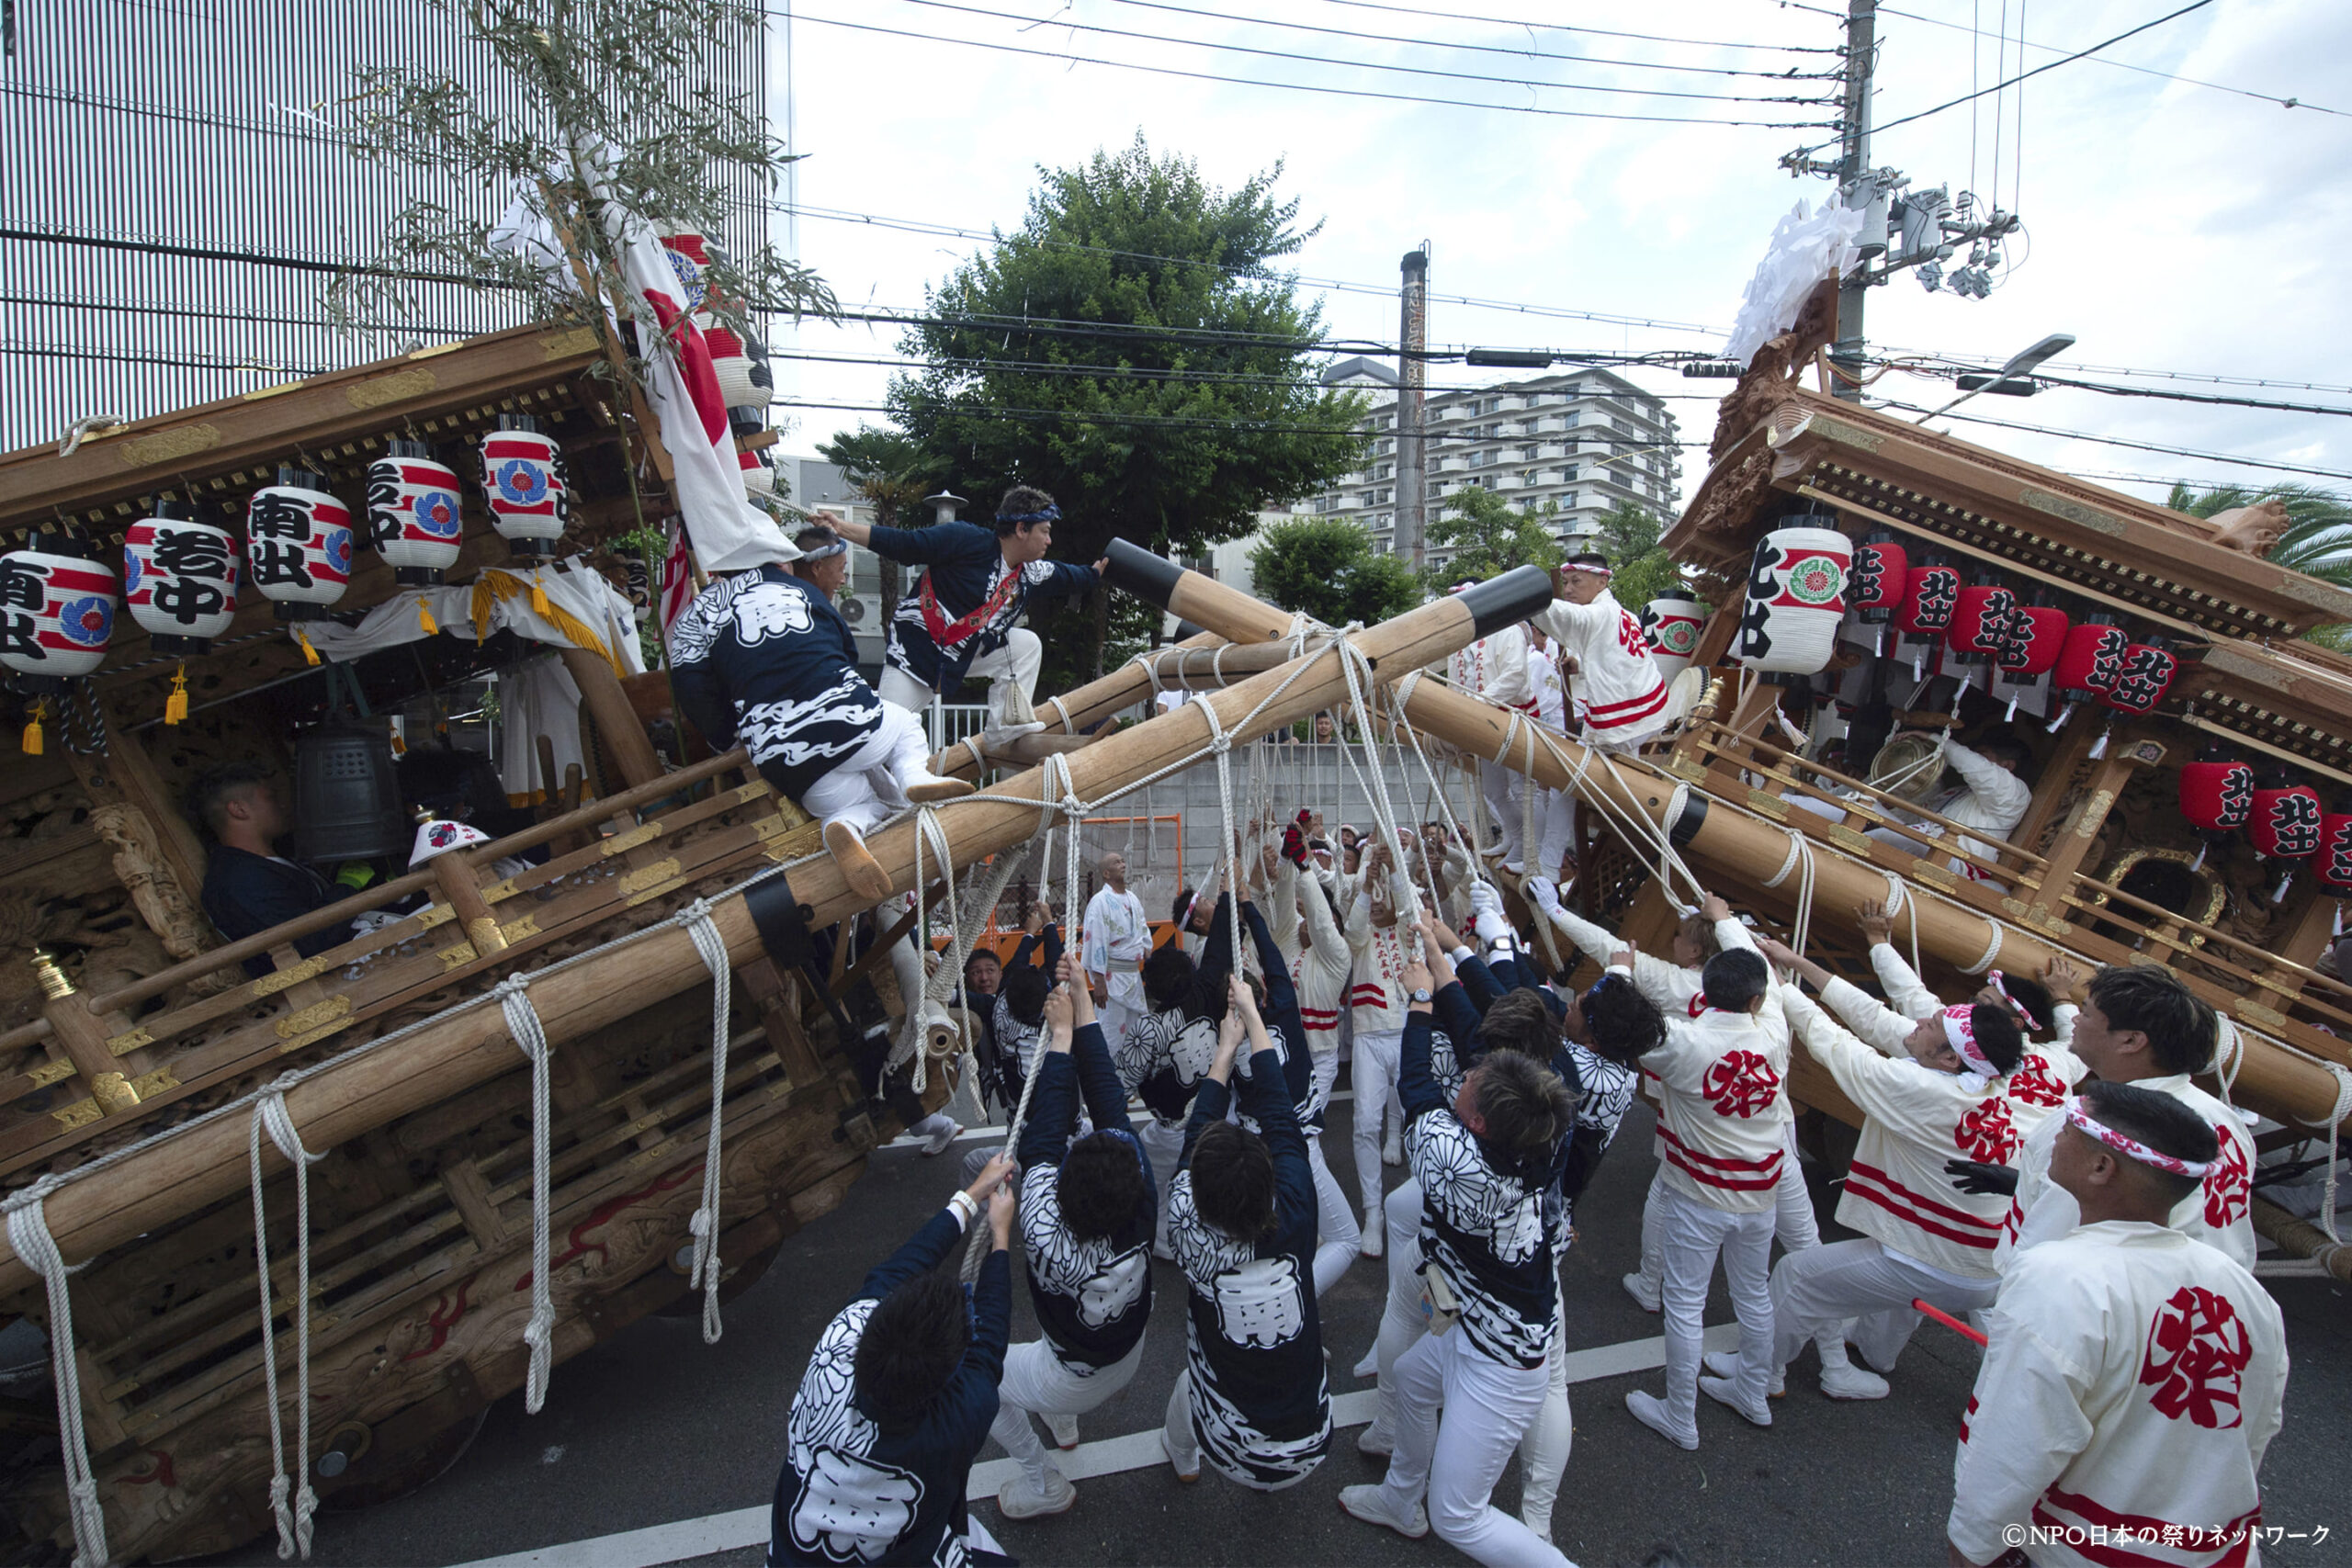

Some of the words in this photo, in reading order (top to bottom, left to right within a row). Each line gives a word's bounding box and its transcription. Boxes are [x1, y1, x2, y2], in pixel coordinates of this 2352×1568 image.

[251, 493, 313, 588] 南出
[153, 528, 229, 625] 若中
[1914, 570, 1959, 629] 北出
[1973, 591, 2015, 649] 北出
[2110, 649, 2174, 709] 北出
[2270, 794, 2321, 856] 北出
